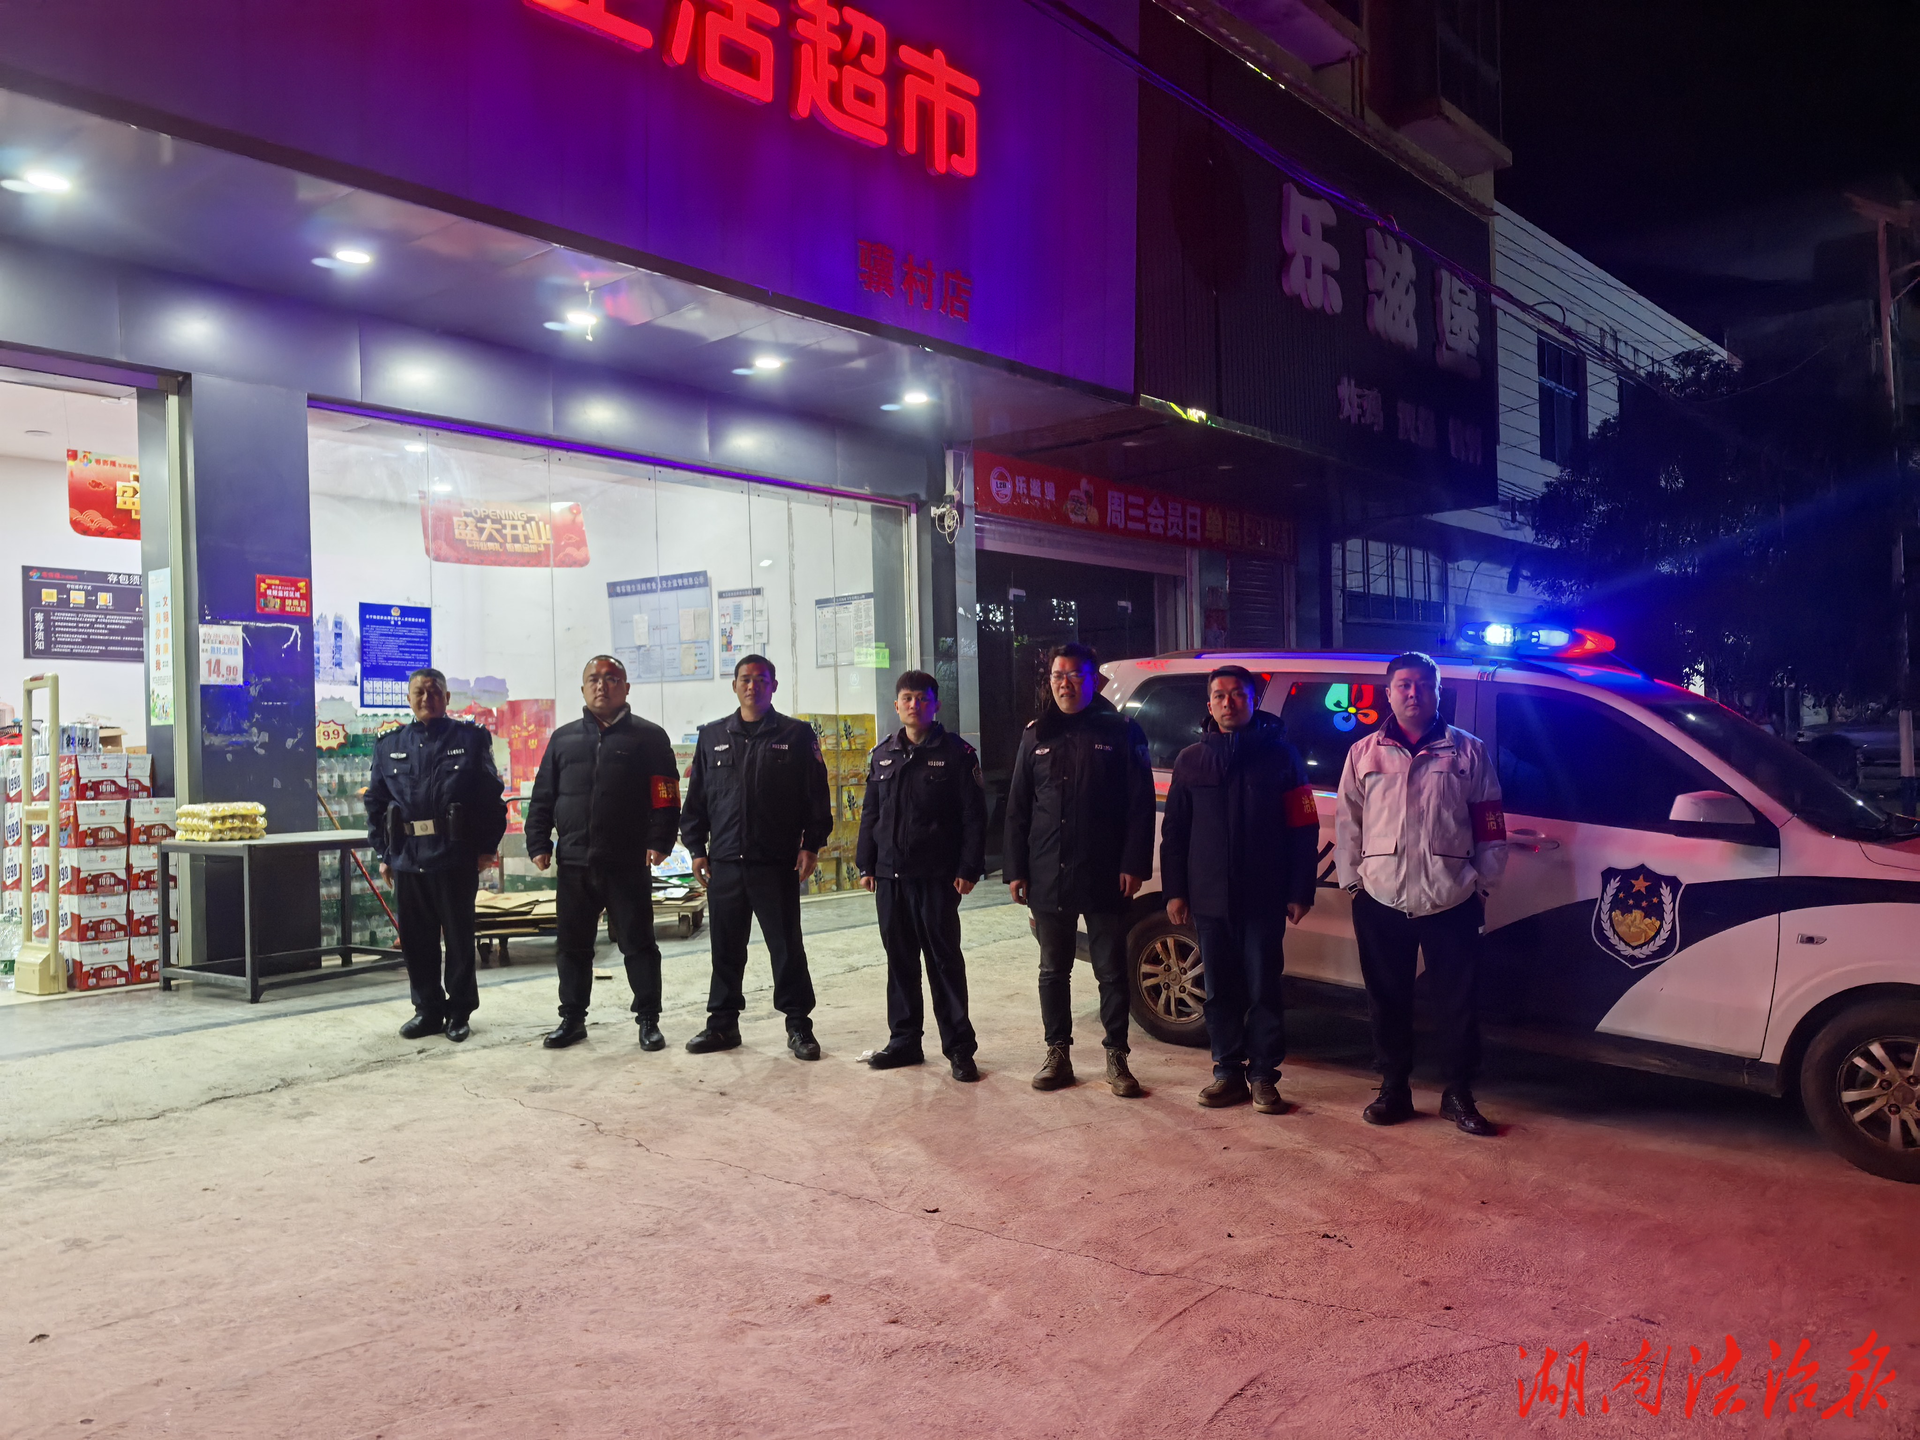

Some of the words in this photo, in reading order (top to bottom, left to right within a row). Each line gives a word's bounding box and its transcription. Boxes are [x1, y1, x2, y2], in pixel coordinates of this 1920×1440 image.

[471, 507, 528, 521] OPENING
[452, 516, 554, 545] 盛大开业
[106, 573, 143, 586] 存包须
[33, 611, 46, 651] 寄存须知
[205, 658, 239, 679] 14.90
[322, 728, 341, 741] 9.9
[8, 774, 21, 793] 1998
[32, 773, 45, 793] 1998
[5, 820, 20, 842] 1998
[4, 864, 18, 881] 1998
[31, 864, 43, 880] 998
[32, 909, 44, 927] 998
